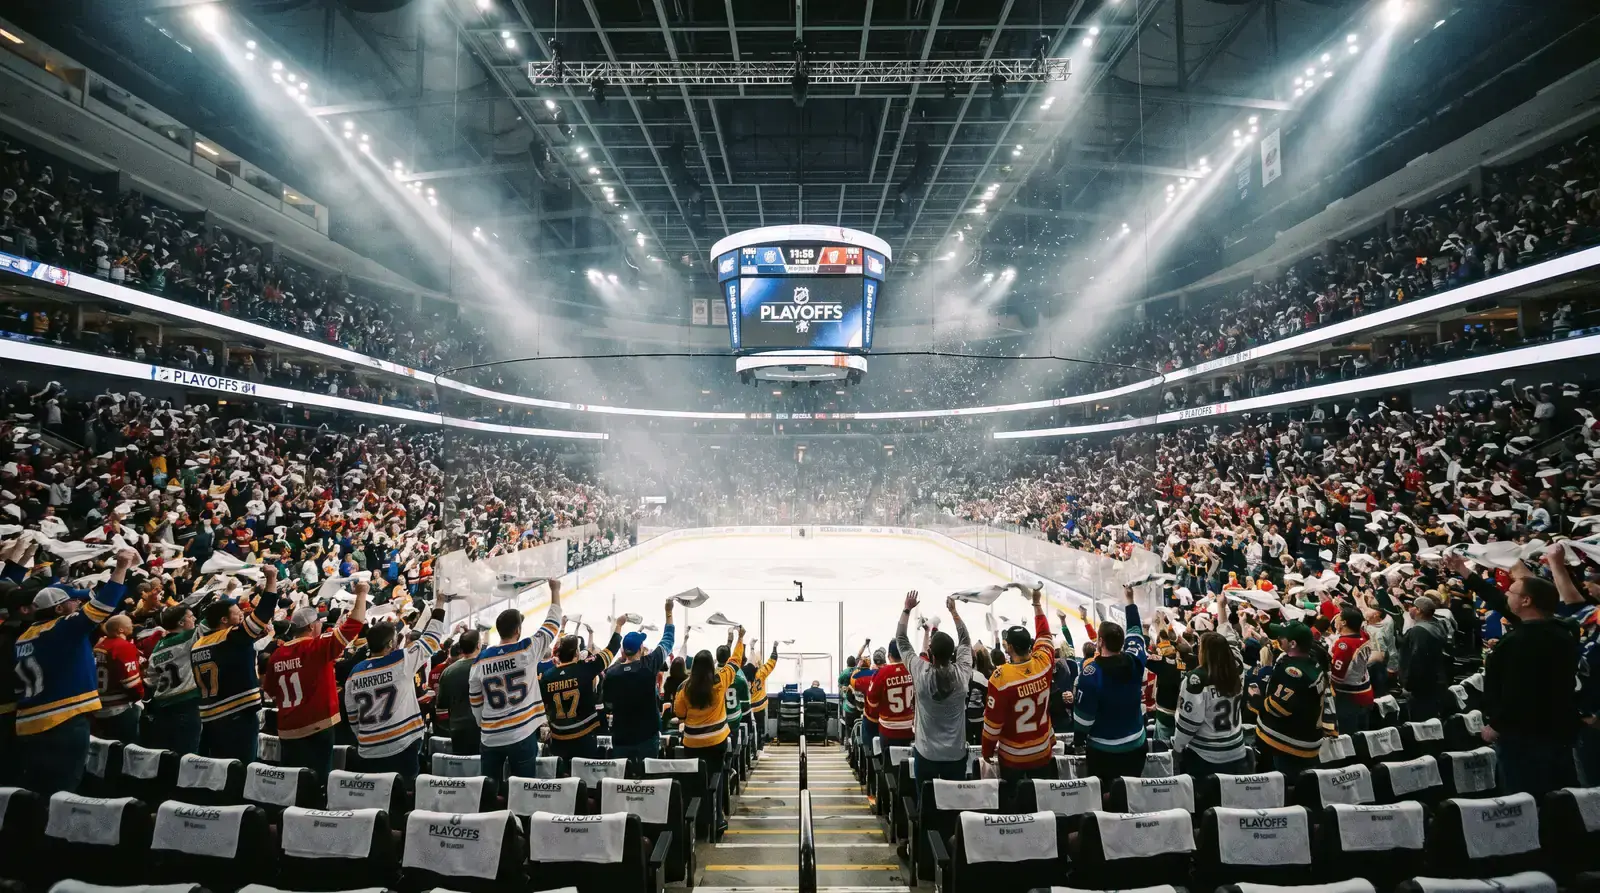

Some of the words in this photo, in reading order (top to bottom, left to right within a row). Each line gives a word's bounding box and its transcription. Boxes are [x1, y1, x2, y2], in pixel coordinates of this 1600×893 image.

[760, 305, 843, 320] PLAYOFFS
[174, 371, 238, 391] PLAYOFFS
[279, 671, 303, 708] 11
[482, 669, 529, 710] 65
[1274, 684, 1295, 701] 17
[354, 683, 398, 724] 27
[552, 688, 580, 719] 17
[1014, 687, 1051, 734] 27
[340, 780, 375, 789] PLAYOFFS
[429, 779, 466, 788] PLAYOFFS
[523, 782, 562, 791] PLAYOFFS
[617, 784, 655, 793] PLAYOFFS
[984, 814, 1034, 824] PLAYOFFS
[1240, 817, 1288, 828] PLAYOFFS
[429, 824, 480, 839] PLAYOFFS
